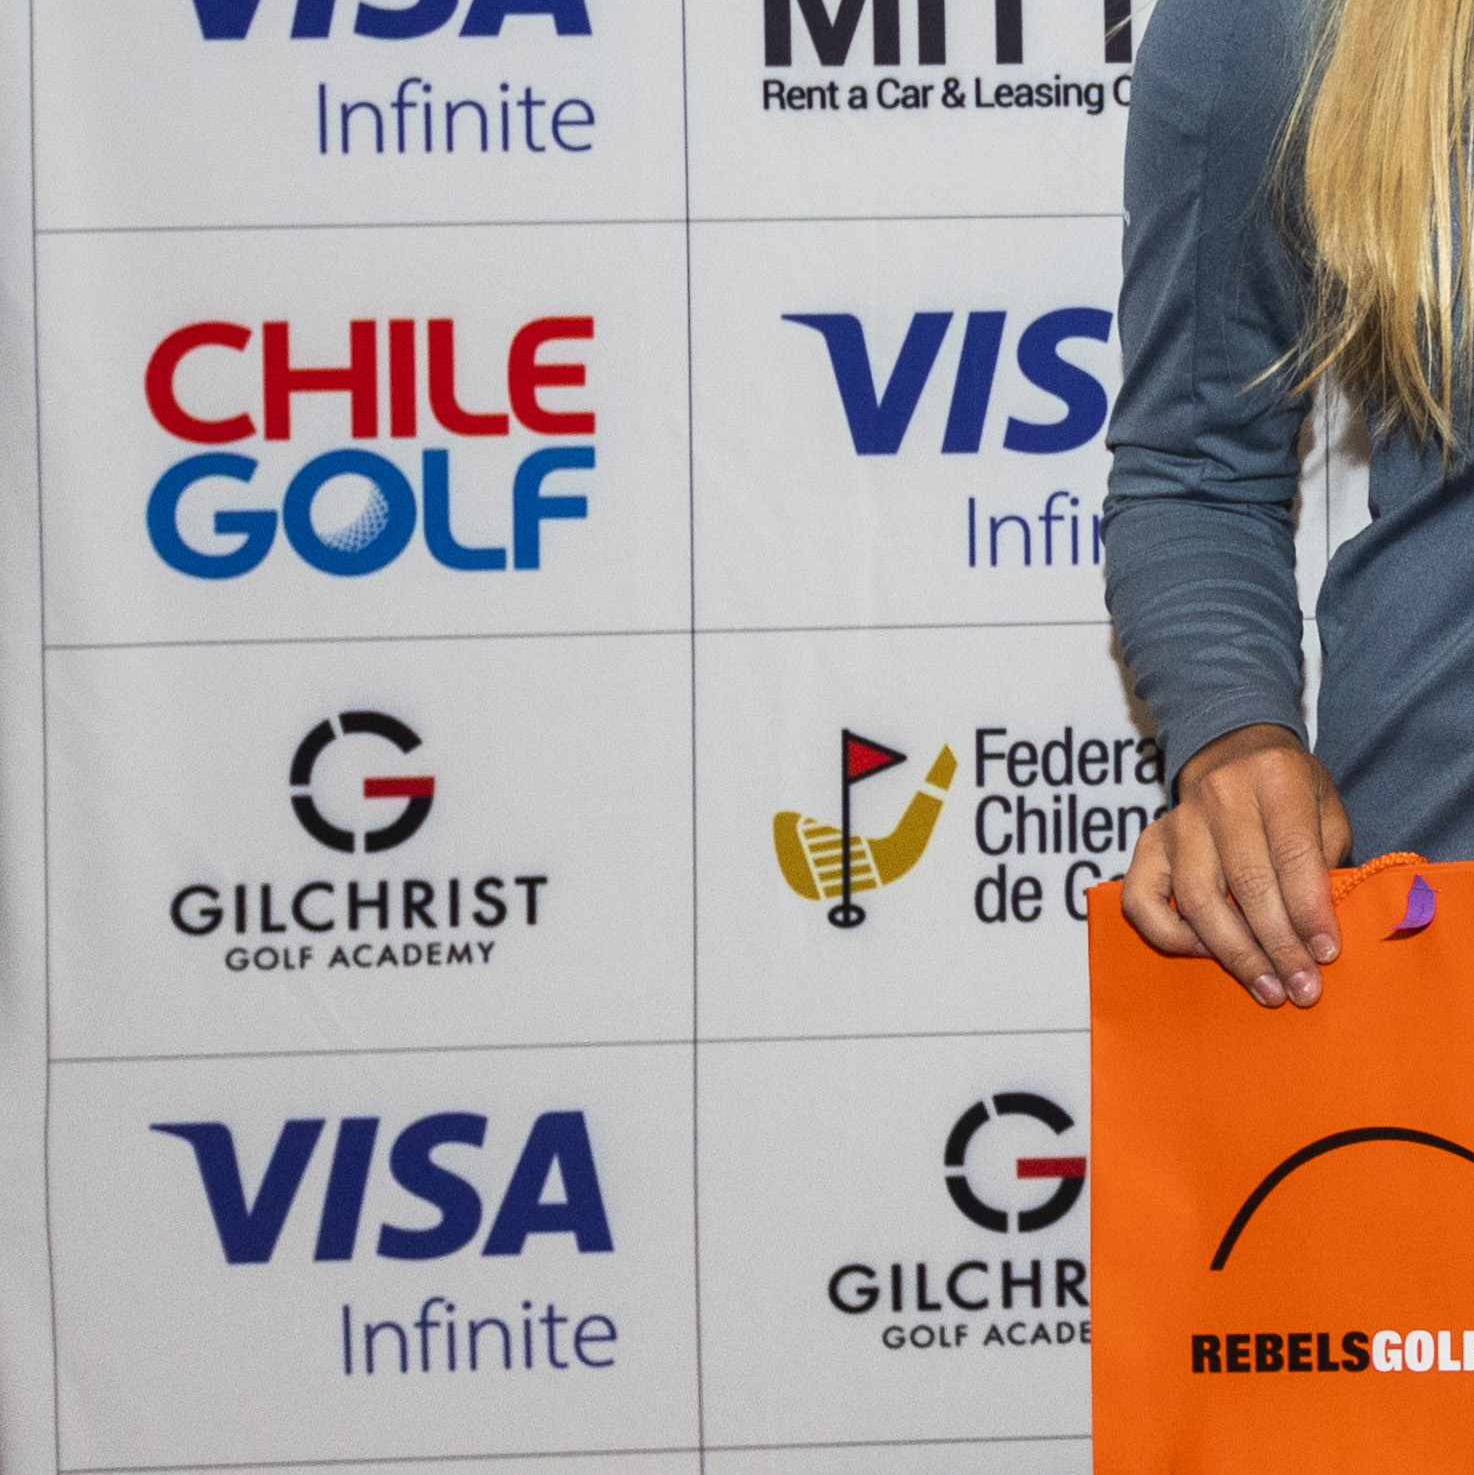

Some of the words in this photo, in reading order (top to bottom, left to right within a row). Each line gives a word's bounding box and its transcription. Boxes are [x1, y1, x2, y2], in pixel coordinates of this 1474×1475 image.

[318, 76, 595, 155] Infinite
[762, 78, 840, 111] Rent
[847, 85, 868, 111] a
[876, 77, 935, 110] Car
[941, 76, 966, 109] &
[974, 74, 1105, 116] Leasing
[144, 315, 596, 442] CHILE
[781, 306, 1112, 456] VIS
[145, 445, 596, 581] GOLF
[975, 726, 1166, 788] Federa
[975, 793, 1168, 856] Chilen
[169, 875, 548, 935] GILCHRIST
[974, 863, 1043, 924] de
[224, 946, 312, 972] GOLF
[328, 941, 495, 968] ACADEMY
[149, 1110, 615, 1266] VISA
[827, 1257, 1089, 1315] GILCHR
[342, 1296, 618, 1376] Infinite
[882, 1324, 968, 1350] GOLF
[983, 1320, 1090, 1346] ACADE
